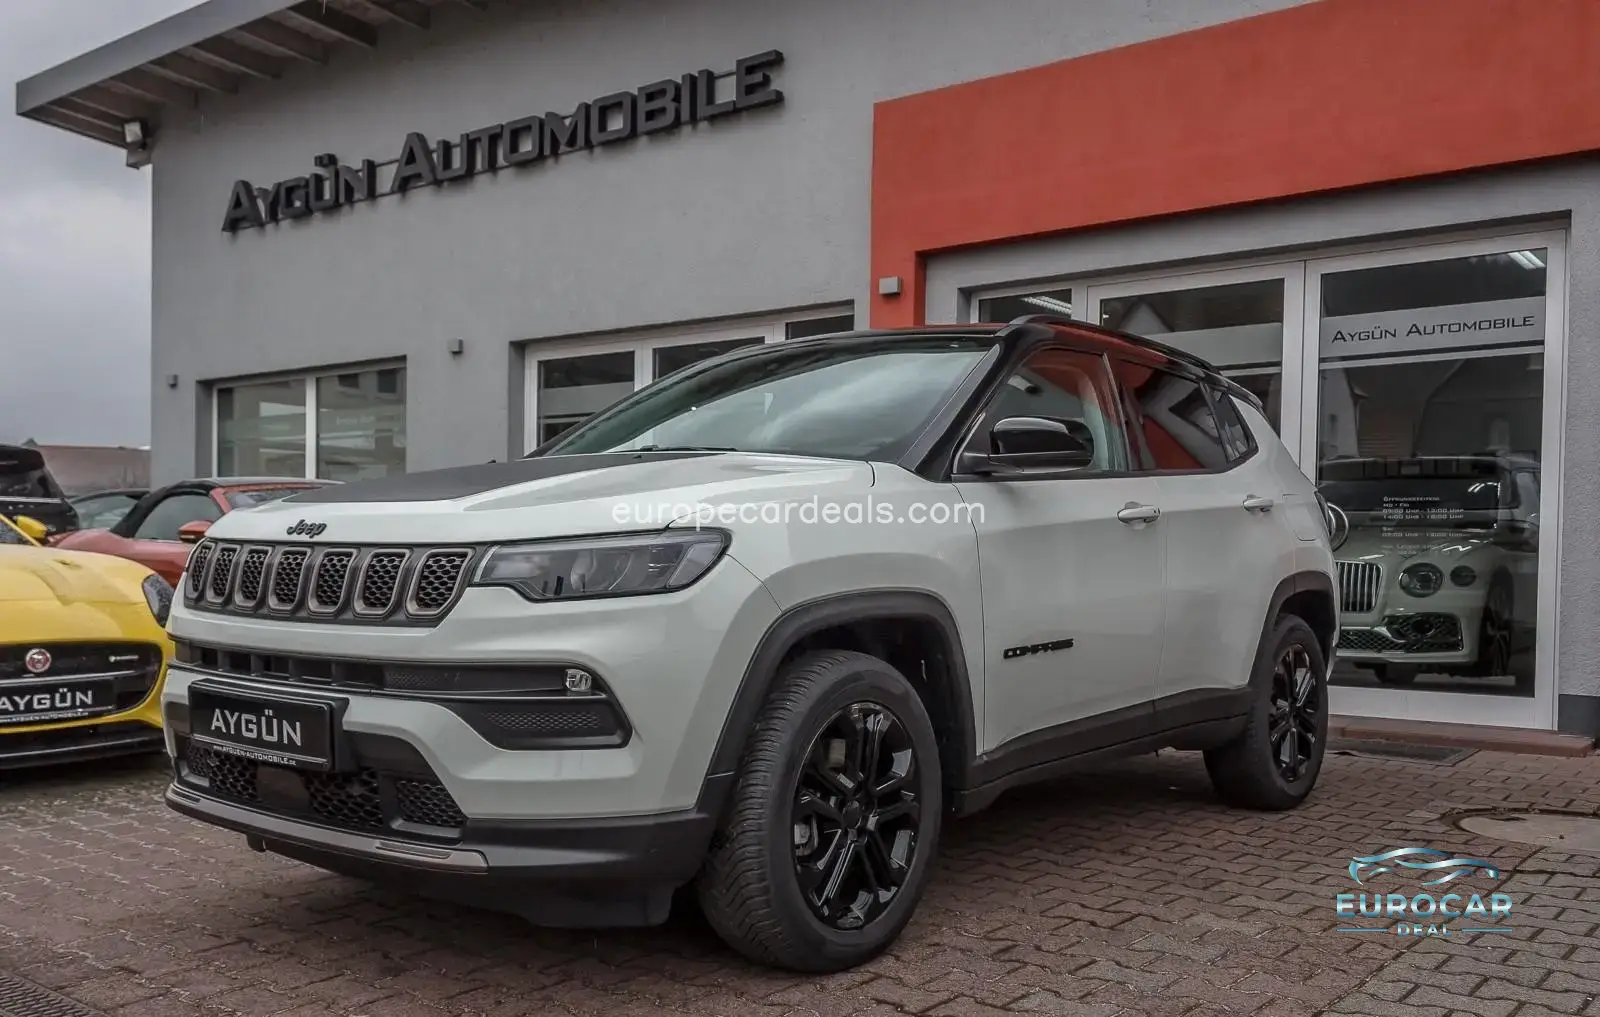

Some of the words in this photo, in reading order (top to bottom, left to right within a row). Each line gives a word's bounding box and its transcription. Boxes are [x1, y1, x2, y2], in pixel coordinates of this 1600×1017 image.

[221, 153, 375, 232] AYGÜN
[391, 49, 785, 193] AUTOMOBILE
[1332, 325, 1397, 343] AYGÜN
[1406, 315, 1535, 337] AUTOMOBILE
[286, 518, 328, 539] Jeep
[0, 688, 93, 712] AYGÜN
[210, 708, 303, 747] AYGÜN
